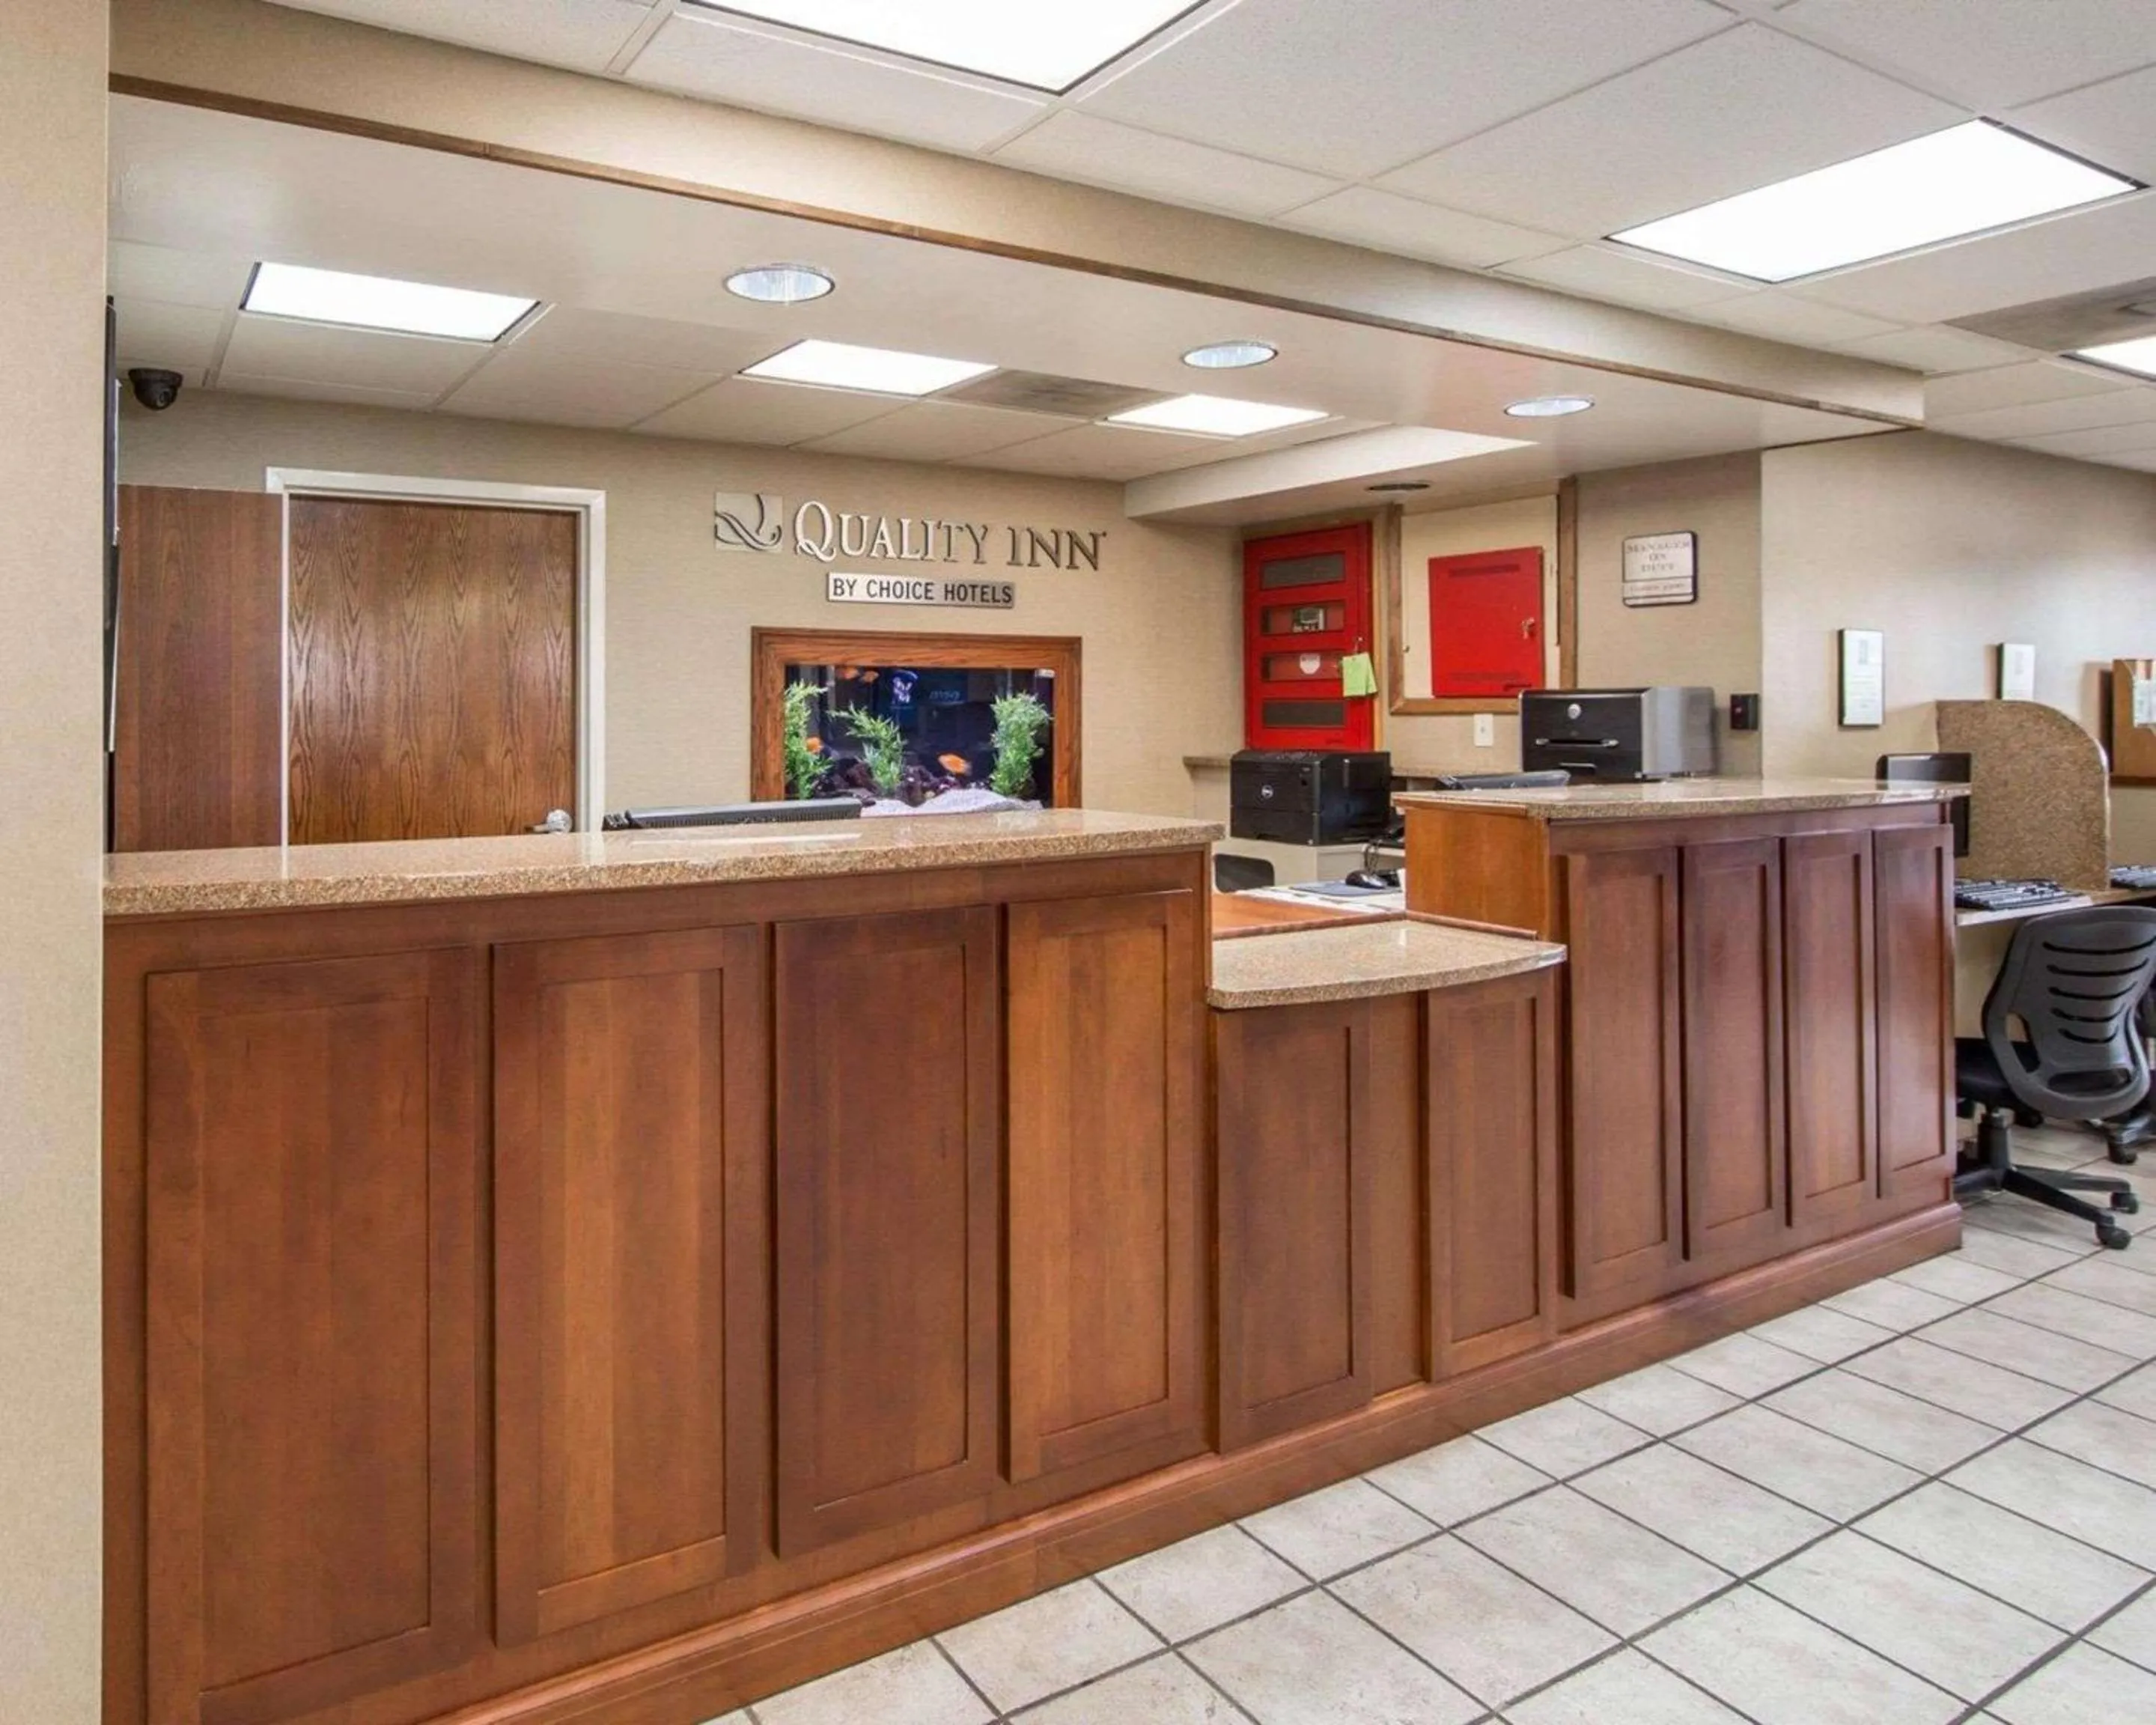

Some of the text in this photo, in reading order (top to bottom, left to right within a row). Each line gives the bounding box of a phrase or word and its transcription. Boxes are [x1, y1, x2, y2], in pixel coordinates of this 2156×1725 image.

[794, 500, 1103, 571] QUALITY INN
[832, 578, 1013, 603] BY CHOICE HOTELS
